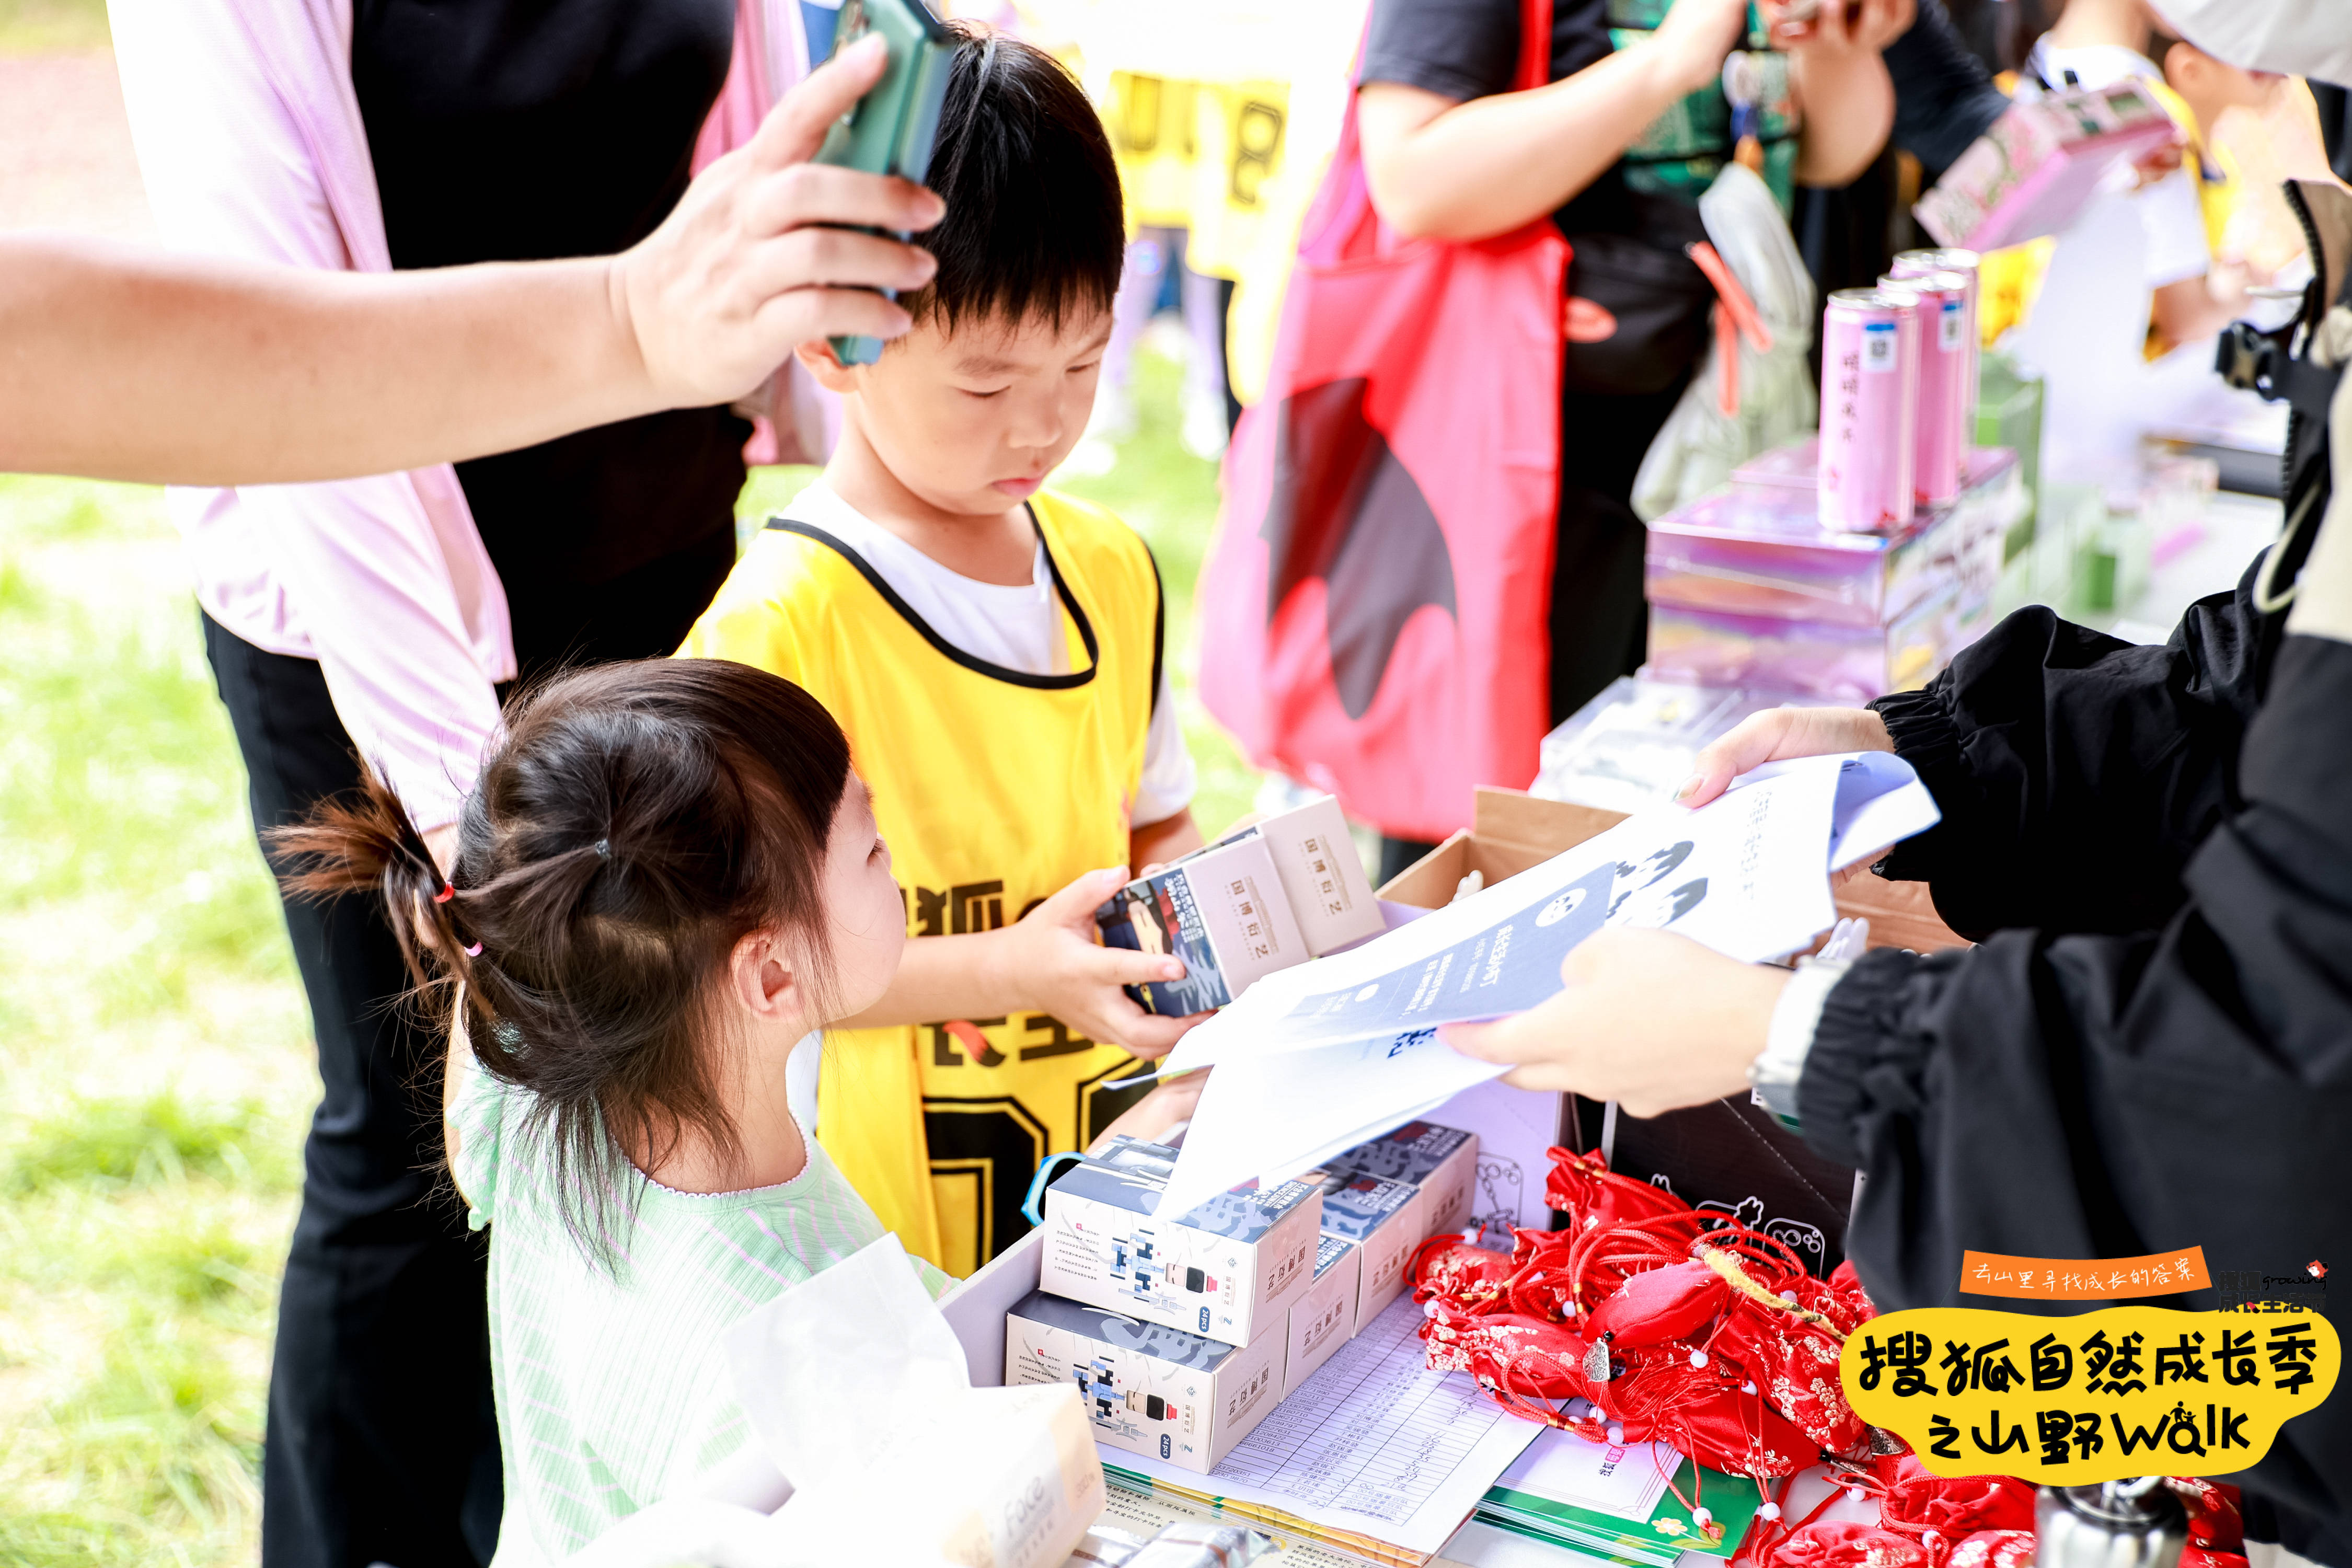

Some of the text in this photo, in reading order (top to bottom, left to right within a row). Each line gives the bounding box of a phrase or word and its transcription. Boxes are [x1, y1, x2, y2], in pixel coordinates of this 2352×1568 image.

[1231, 880, 1268, 958] 国博衍艺
[1267, 1246, 1306, 1290] 国博衍艺
[1201, 1309, 1209, 1330] 24pcs
[1304, 1300, 1343, 1346] 国博衍艺
[1229, 1367, 1269, 1416] 国博衍艺
[1161, 1436, 1170, 1457] 24pcs
